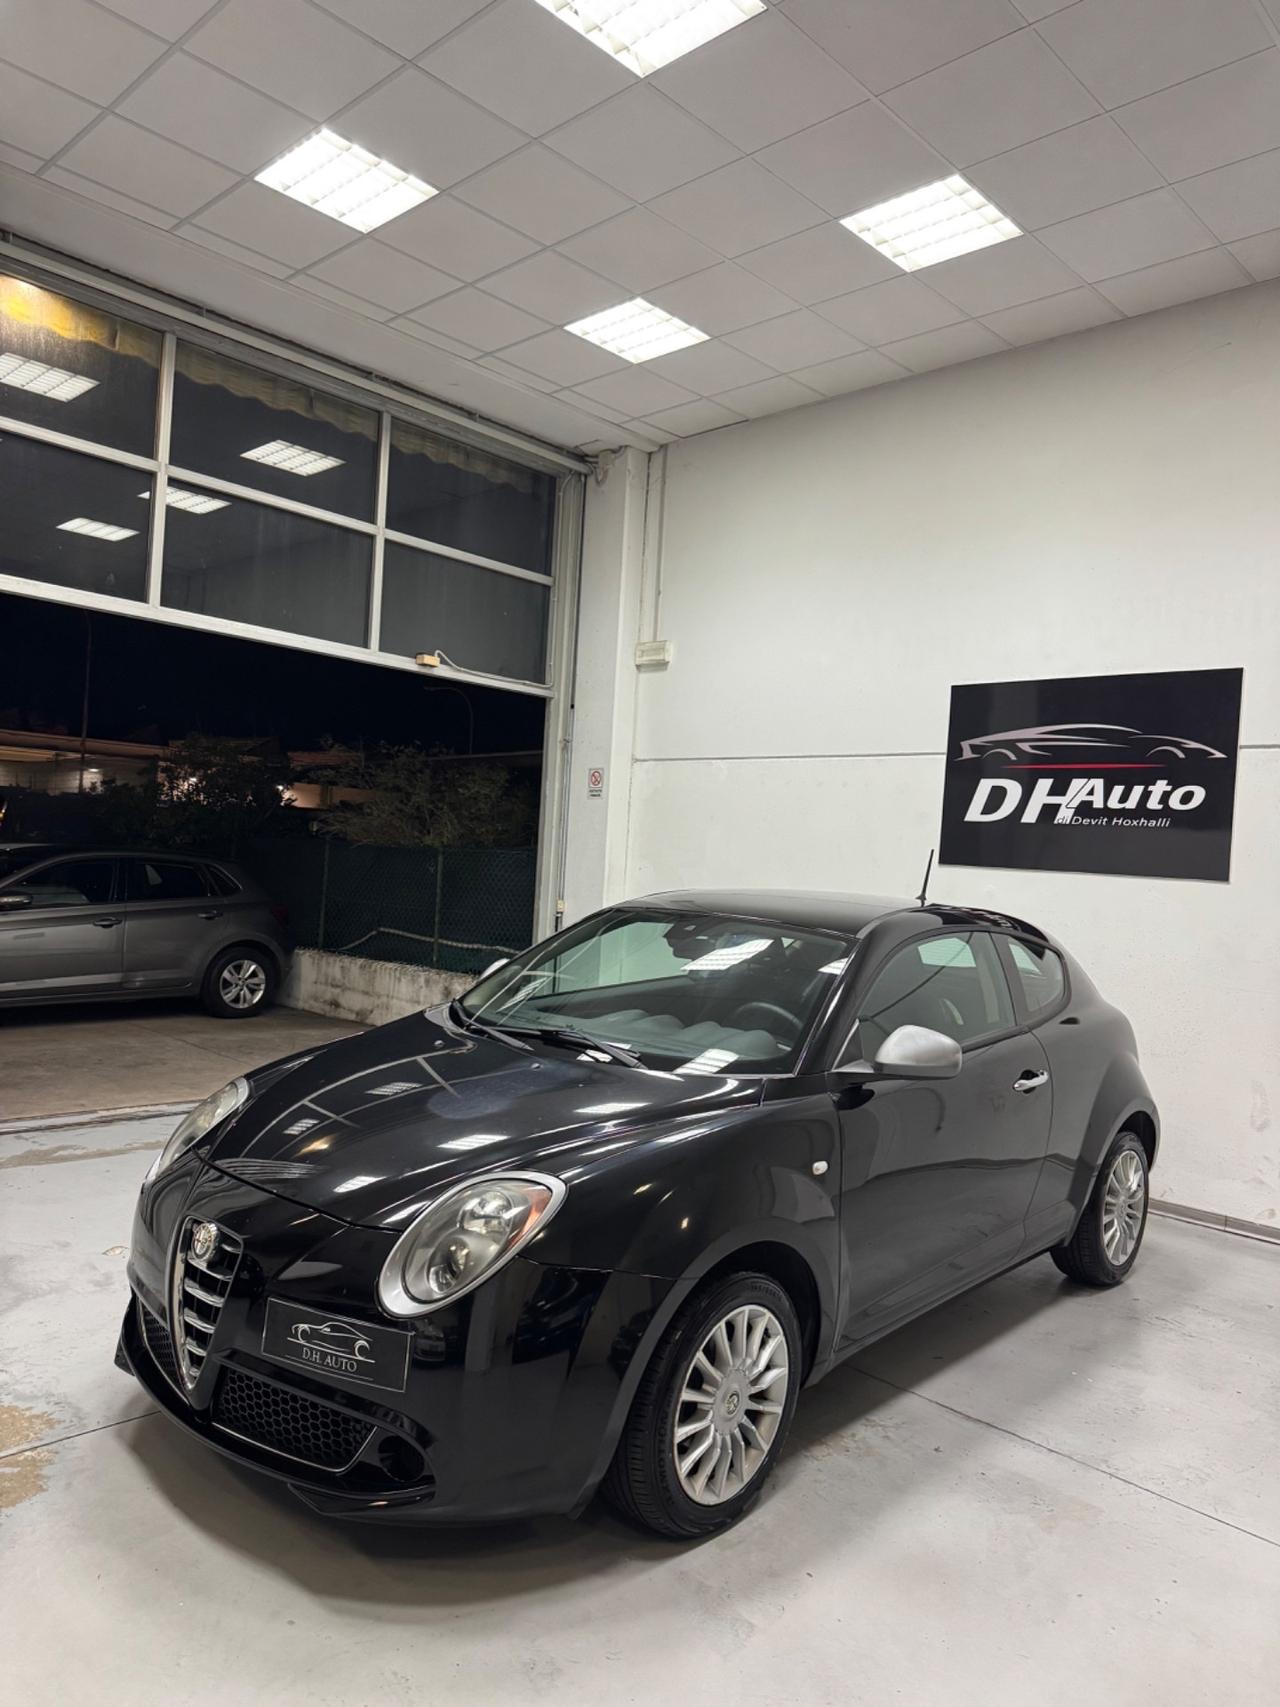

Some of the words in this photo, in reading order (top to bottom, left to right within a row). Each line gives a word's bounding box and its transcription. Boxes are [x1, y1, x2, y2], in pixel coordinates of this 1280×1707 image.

[1071, 816, 1108, 826] Devit
[1111, 817, 1171, 828] Hoxhalli
[303, 1347, 321, 1363] D.H.
[324, 1355, 357, 1372] AUTO
